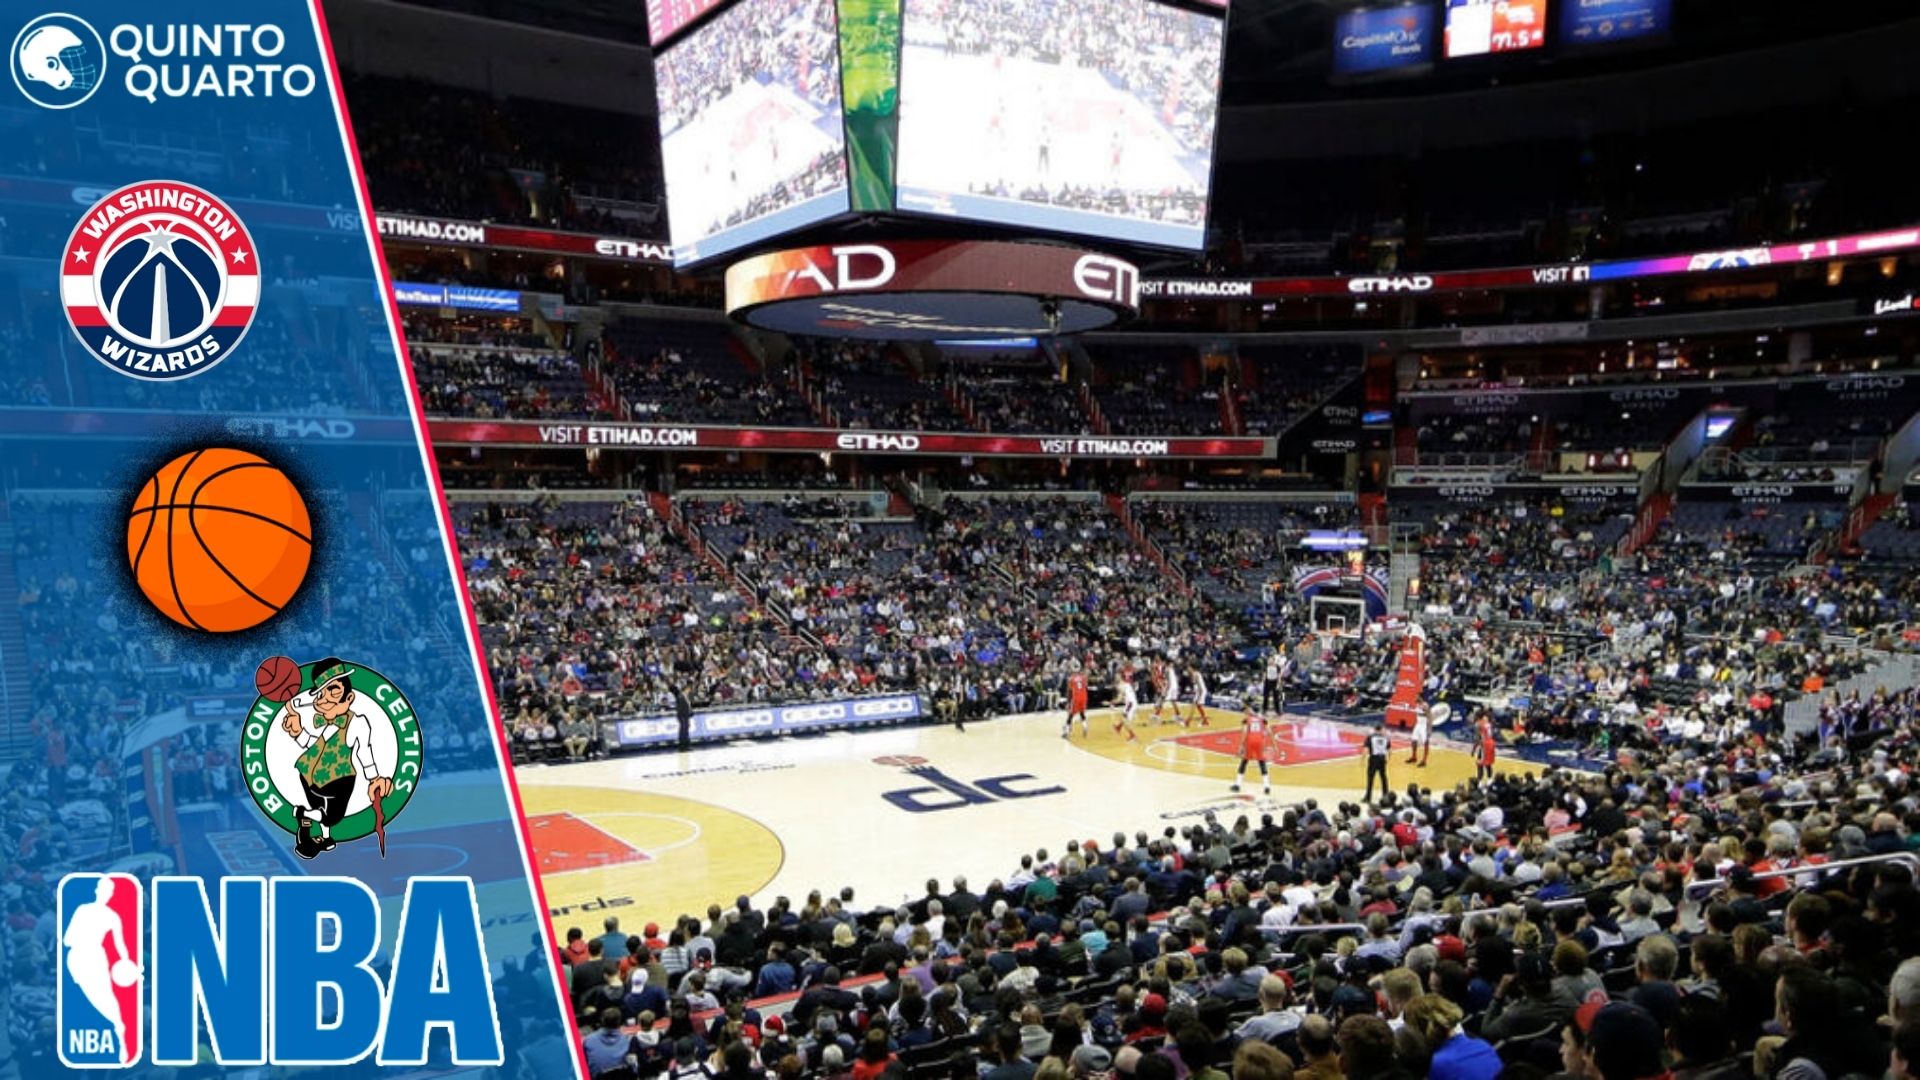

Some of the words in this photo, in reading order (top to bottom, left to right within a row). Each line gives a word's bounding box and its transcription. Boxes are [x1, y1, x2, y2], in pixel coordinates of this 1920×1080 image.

[1532, 267, 1570, 283] VISIT
[1167, 281, 1252, 296] ETIHAD.COM
[1348, 276, 1433, 293] ETIHAD
[539, 426, 582, 444] VISIT
[588, 427, 698, 446] ETIHAD.COM
[837, 433, 920, 450] ETIHAD
[1040, 439, 1077, 454] VISIT
[1077, 440, 1168, 454] ETIHAD.COM
[1438, 486, 1495, 497] ETIHAD
[1731, 486, 1794, 497] ETIHAD
[781, 703, 846, 725] GEICO
[853, 696, 914, 718] GEICO
[624, 718, 696, 739] GEIC
[704, 711, 774, 732] GEICO
